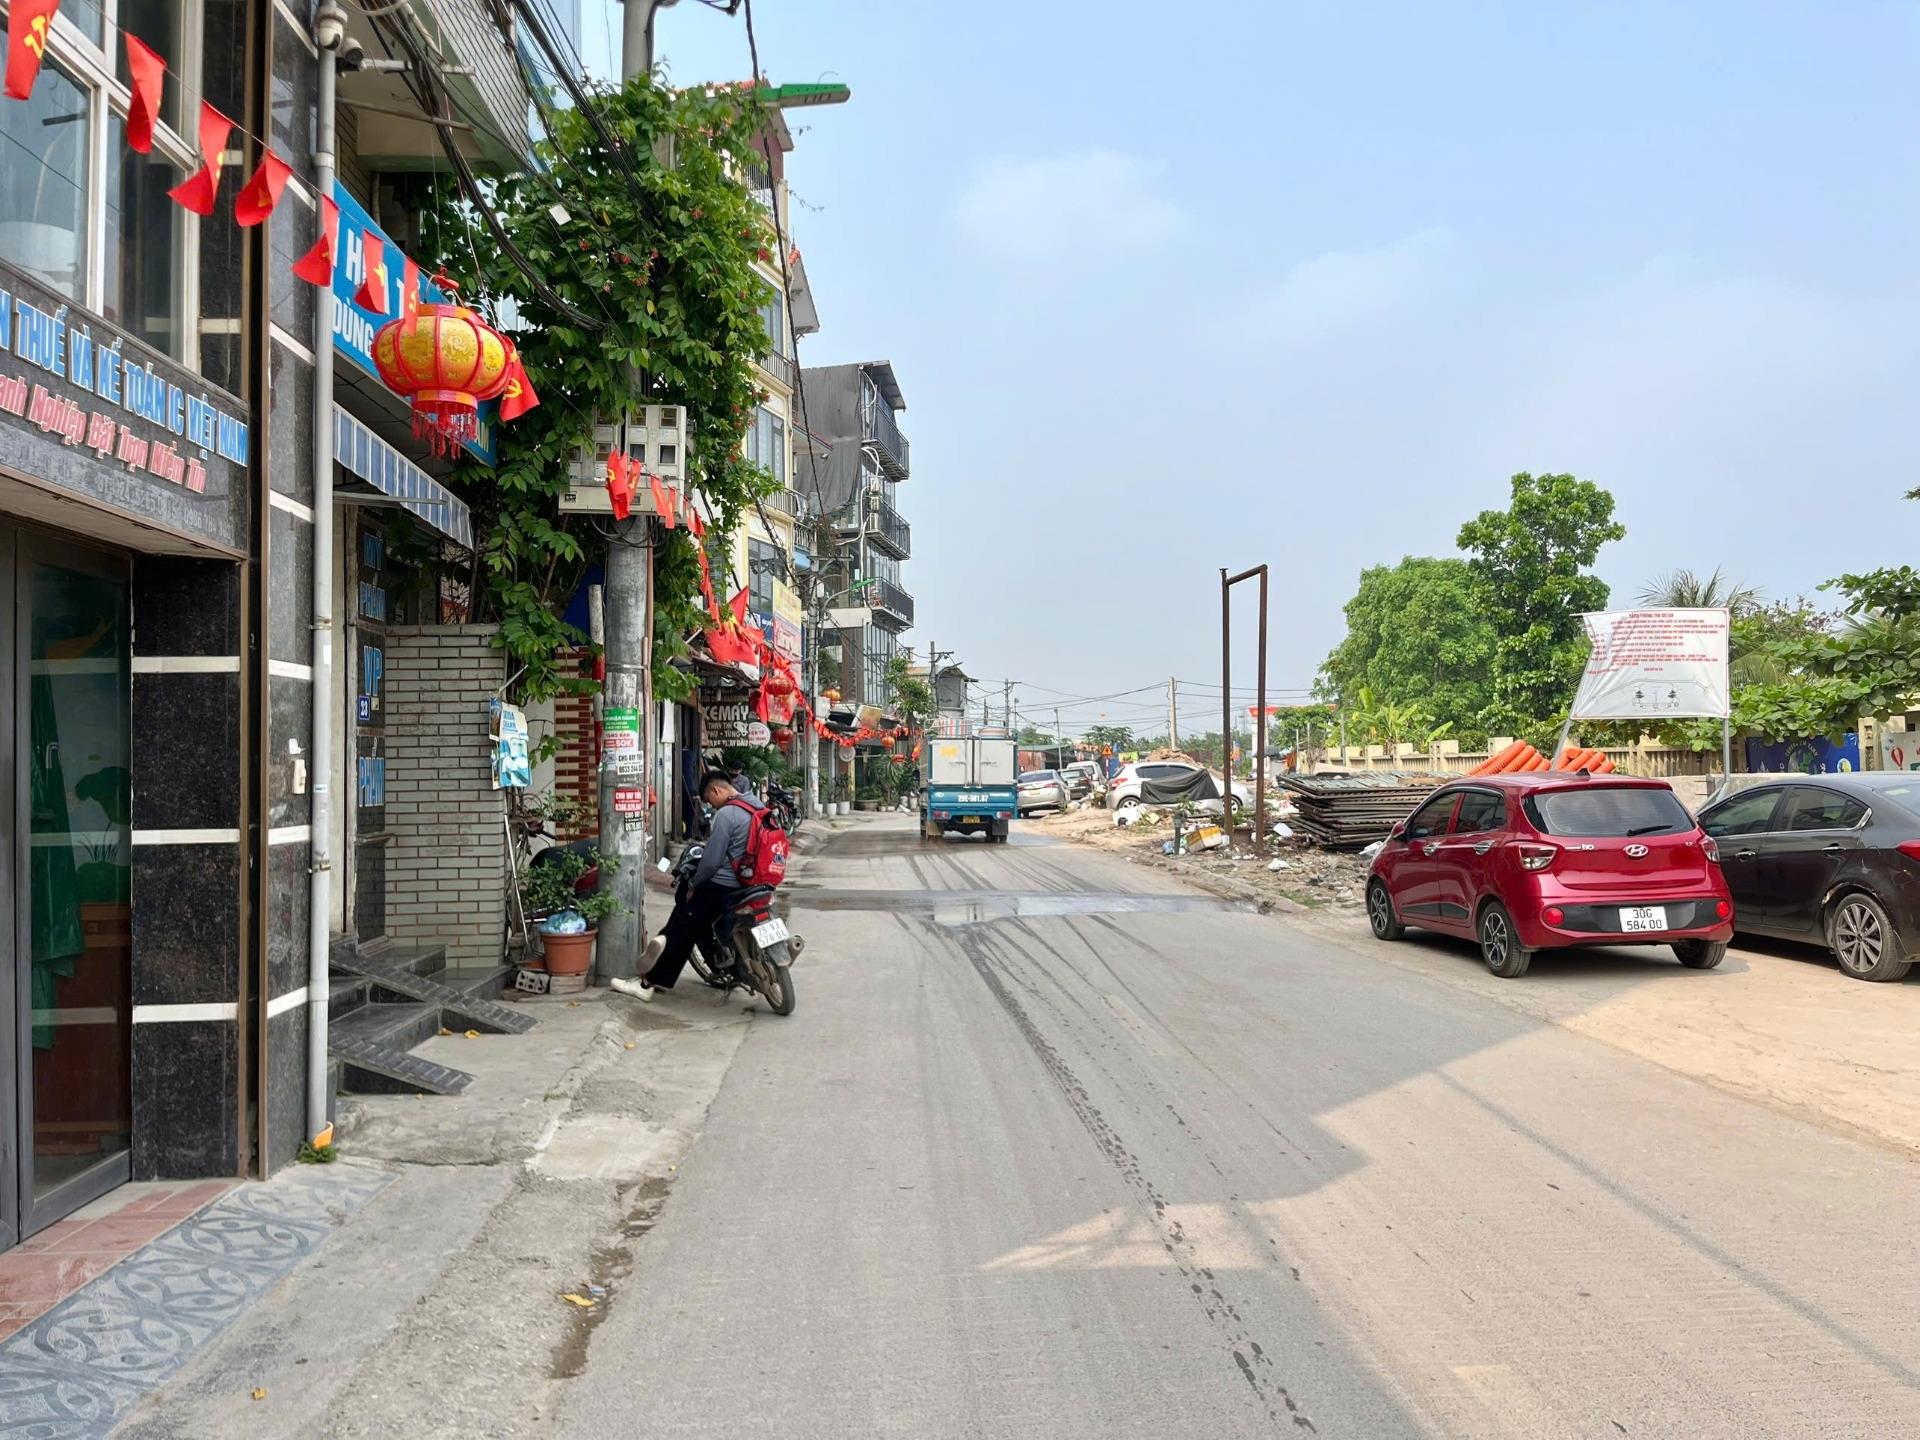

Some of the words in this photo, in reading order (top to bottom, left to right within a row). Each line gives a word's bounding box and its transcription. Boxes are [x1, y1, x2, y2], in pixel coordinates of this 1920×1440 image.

[16, 299, 68, 378] THUẾ
[71, 324, 93, 391] VÀ
[97, 337, 123, 405] KẾ
[124, 359, 166, 427] TOÁN
[187, 393, 217, 460] VIỆT
[218, 411, 247, 467] NAM
[29, 384, 86, 446] Nghiệp
[118, 425, 148, 472] Trọn
[150, 441, 185, 485] Niềm
[1626, 919, 1662, 930] 584.00
[1633, 908, 1653, 919] 30G
